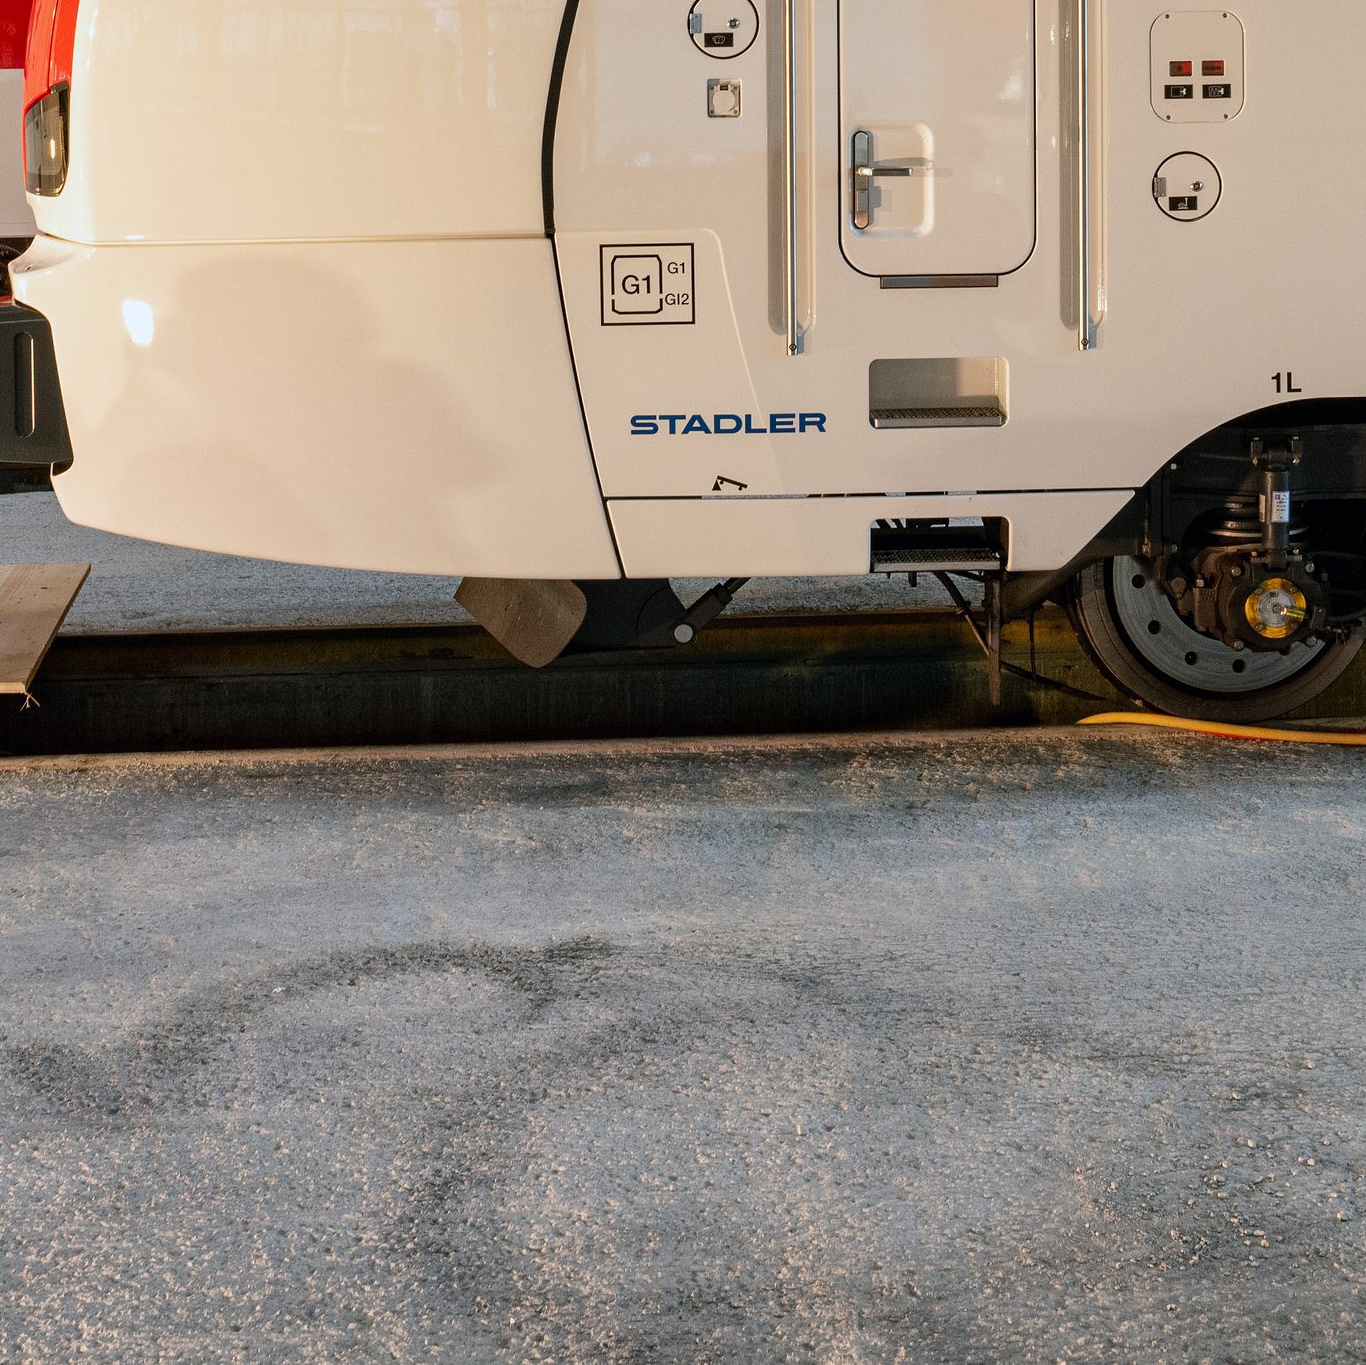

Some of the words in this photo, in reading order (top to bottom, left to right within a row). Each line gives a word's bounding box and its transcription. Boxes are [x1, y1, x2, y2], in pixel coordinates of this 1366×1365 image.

[667, 262, 685, 275] G1
[621, 274, 651, 295] G1
[1271, 371, 1302, 394] 1L
[630, 412, 827, 435] STADLER
